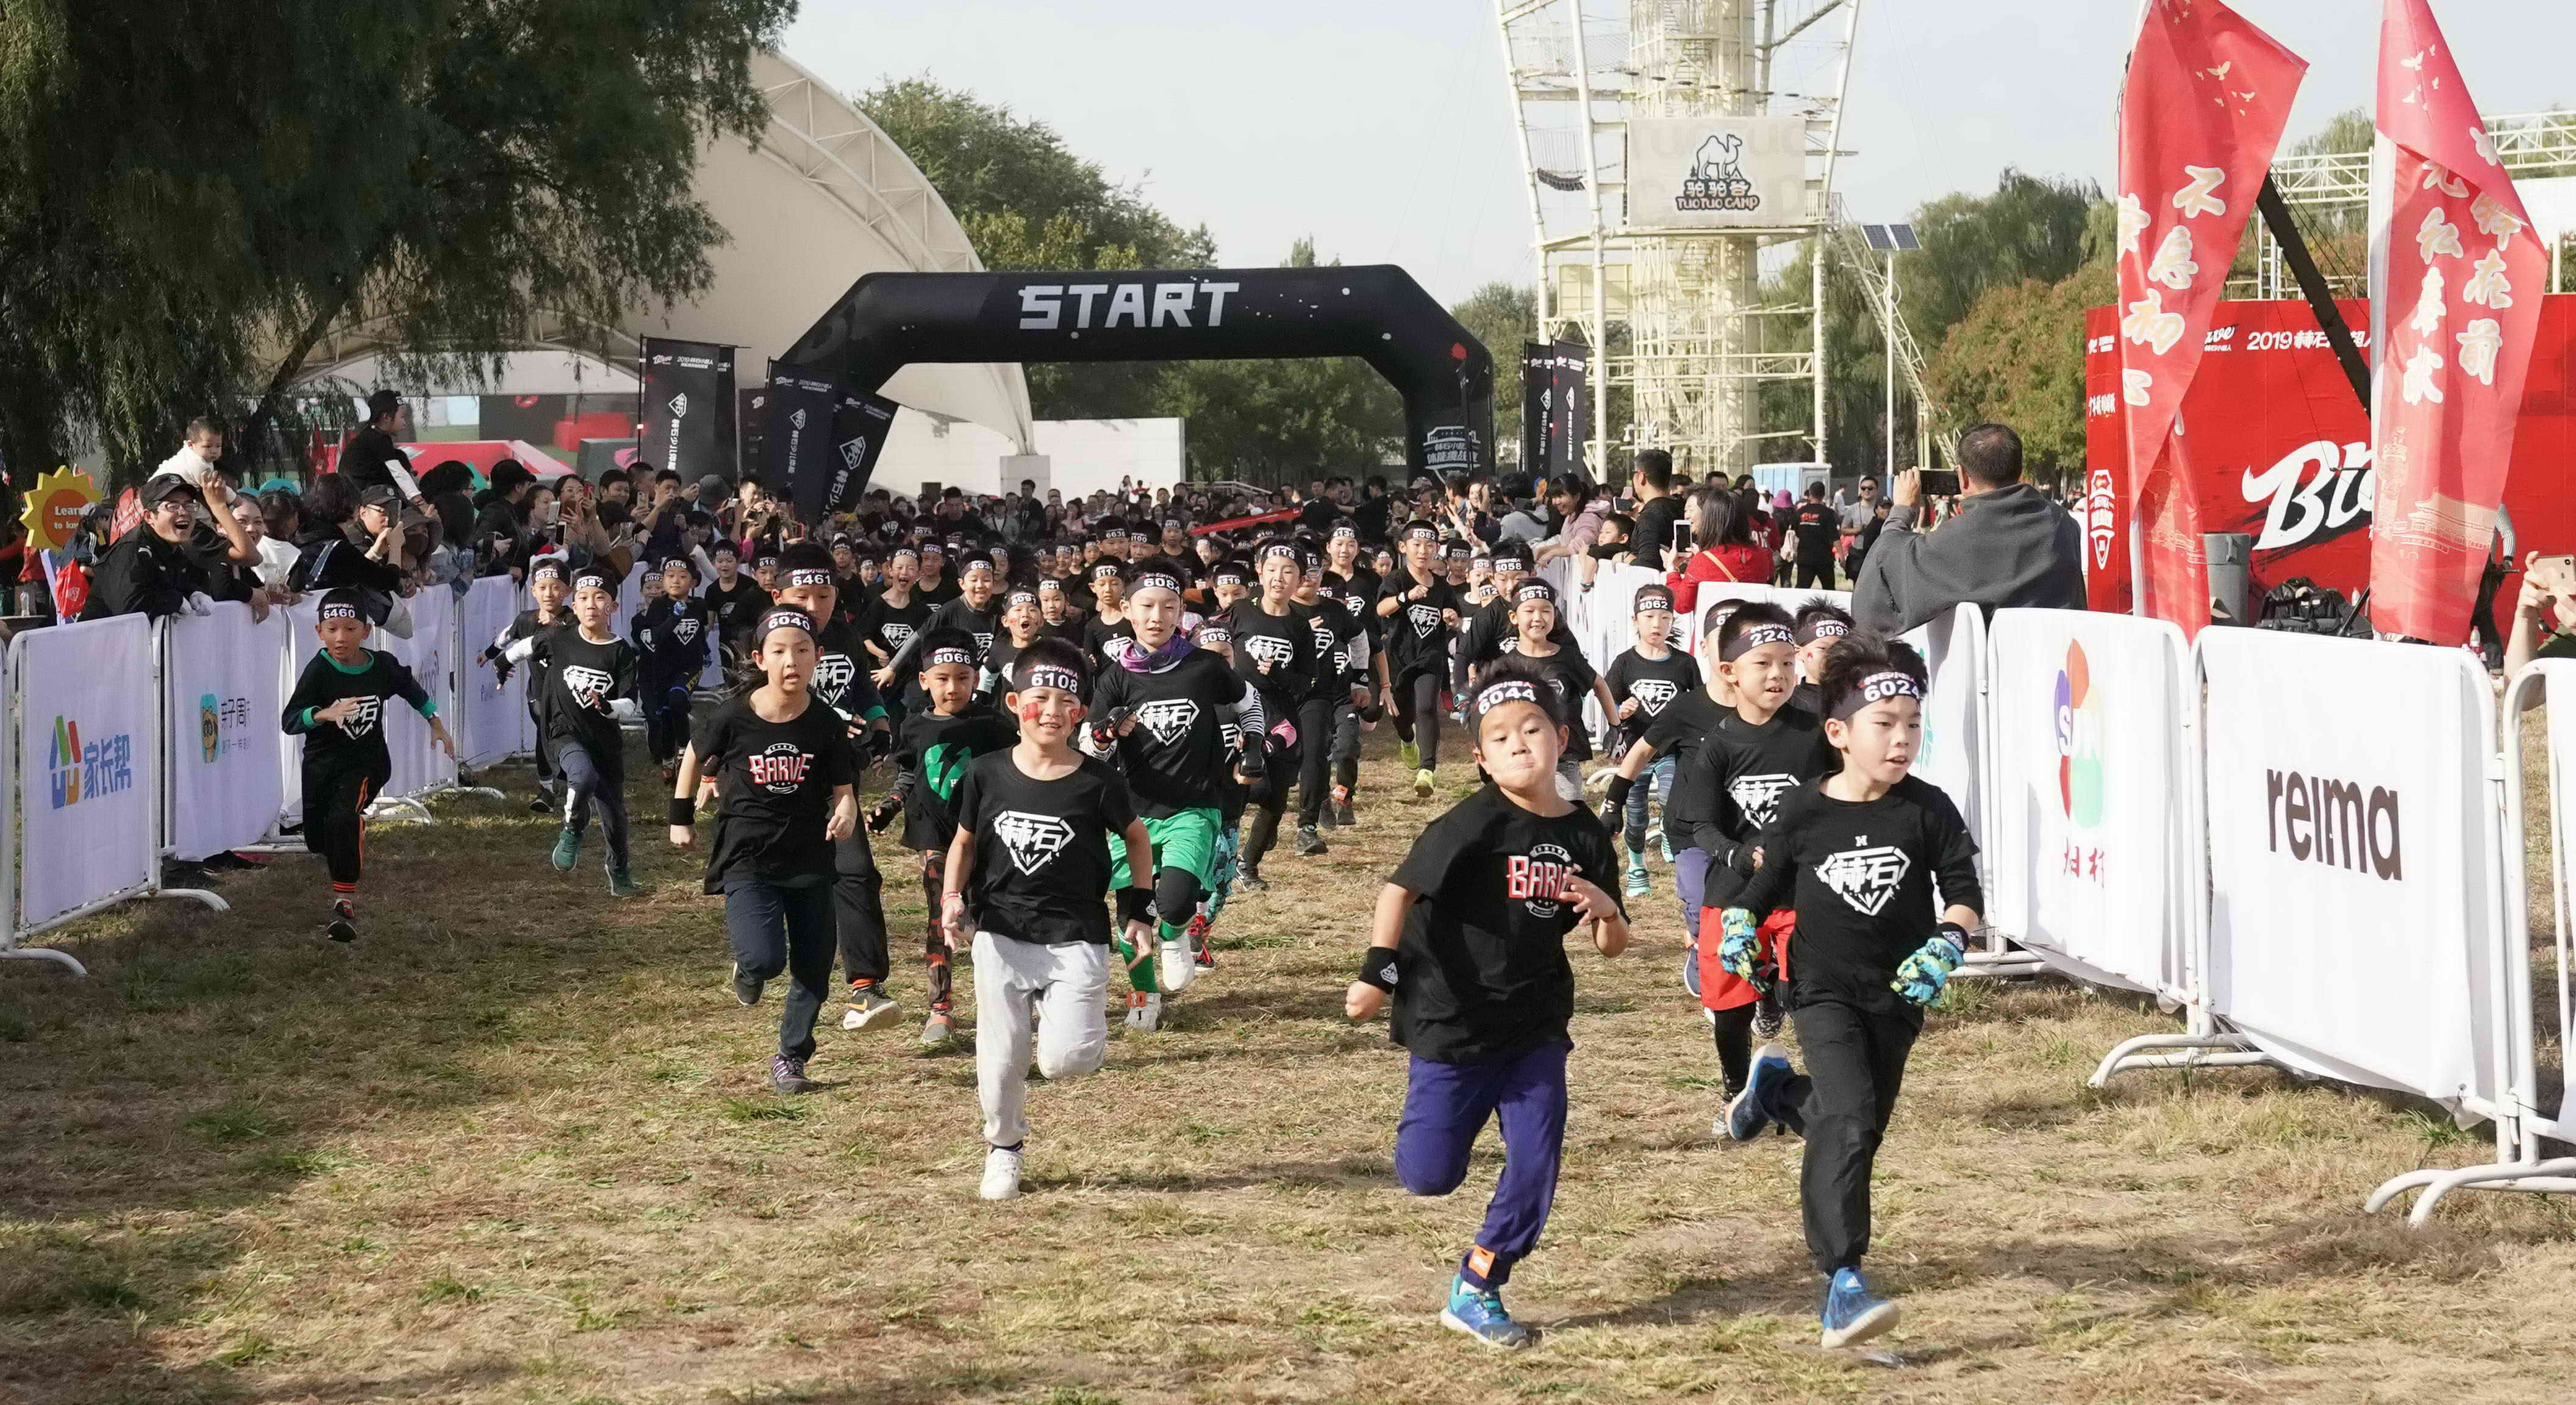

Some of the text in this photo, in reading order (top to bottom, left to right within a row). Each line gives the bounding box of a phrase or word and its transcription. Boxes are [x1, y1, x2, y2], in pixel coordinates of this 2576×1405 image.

[1725, 196, 1758, 210] CAMP
[1019, 282, 1240, 330] START
[1495, 563, 1522, 573] 6058
[576, 578, 604, 591] 6087
[792, 574, 831, 586] 6461
[324, 608, 356, 620] 6460
[1639, 601, 1669, 610] 6062
[768, 616, 810, 631] 6040
[1750, 629, 1794, 648] 2245
[933, 652, 971, 665] 6066
[1031, 672, 1078, 694] 6108
[1864, 679, 1920, 702] 6024
[1478, 687, 1537, 715] 6044
[1142, 705, 1193, 730] 赫石
[83, 733, 132, 800] 家长帮
[748, 753, 814, 785] BARVE
[1001, 817, 1065, 852] 赫石
[2266, 768, 2403, 881] reima
[1828, 854, 1900, 895] 赫石
